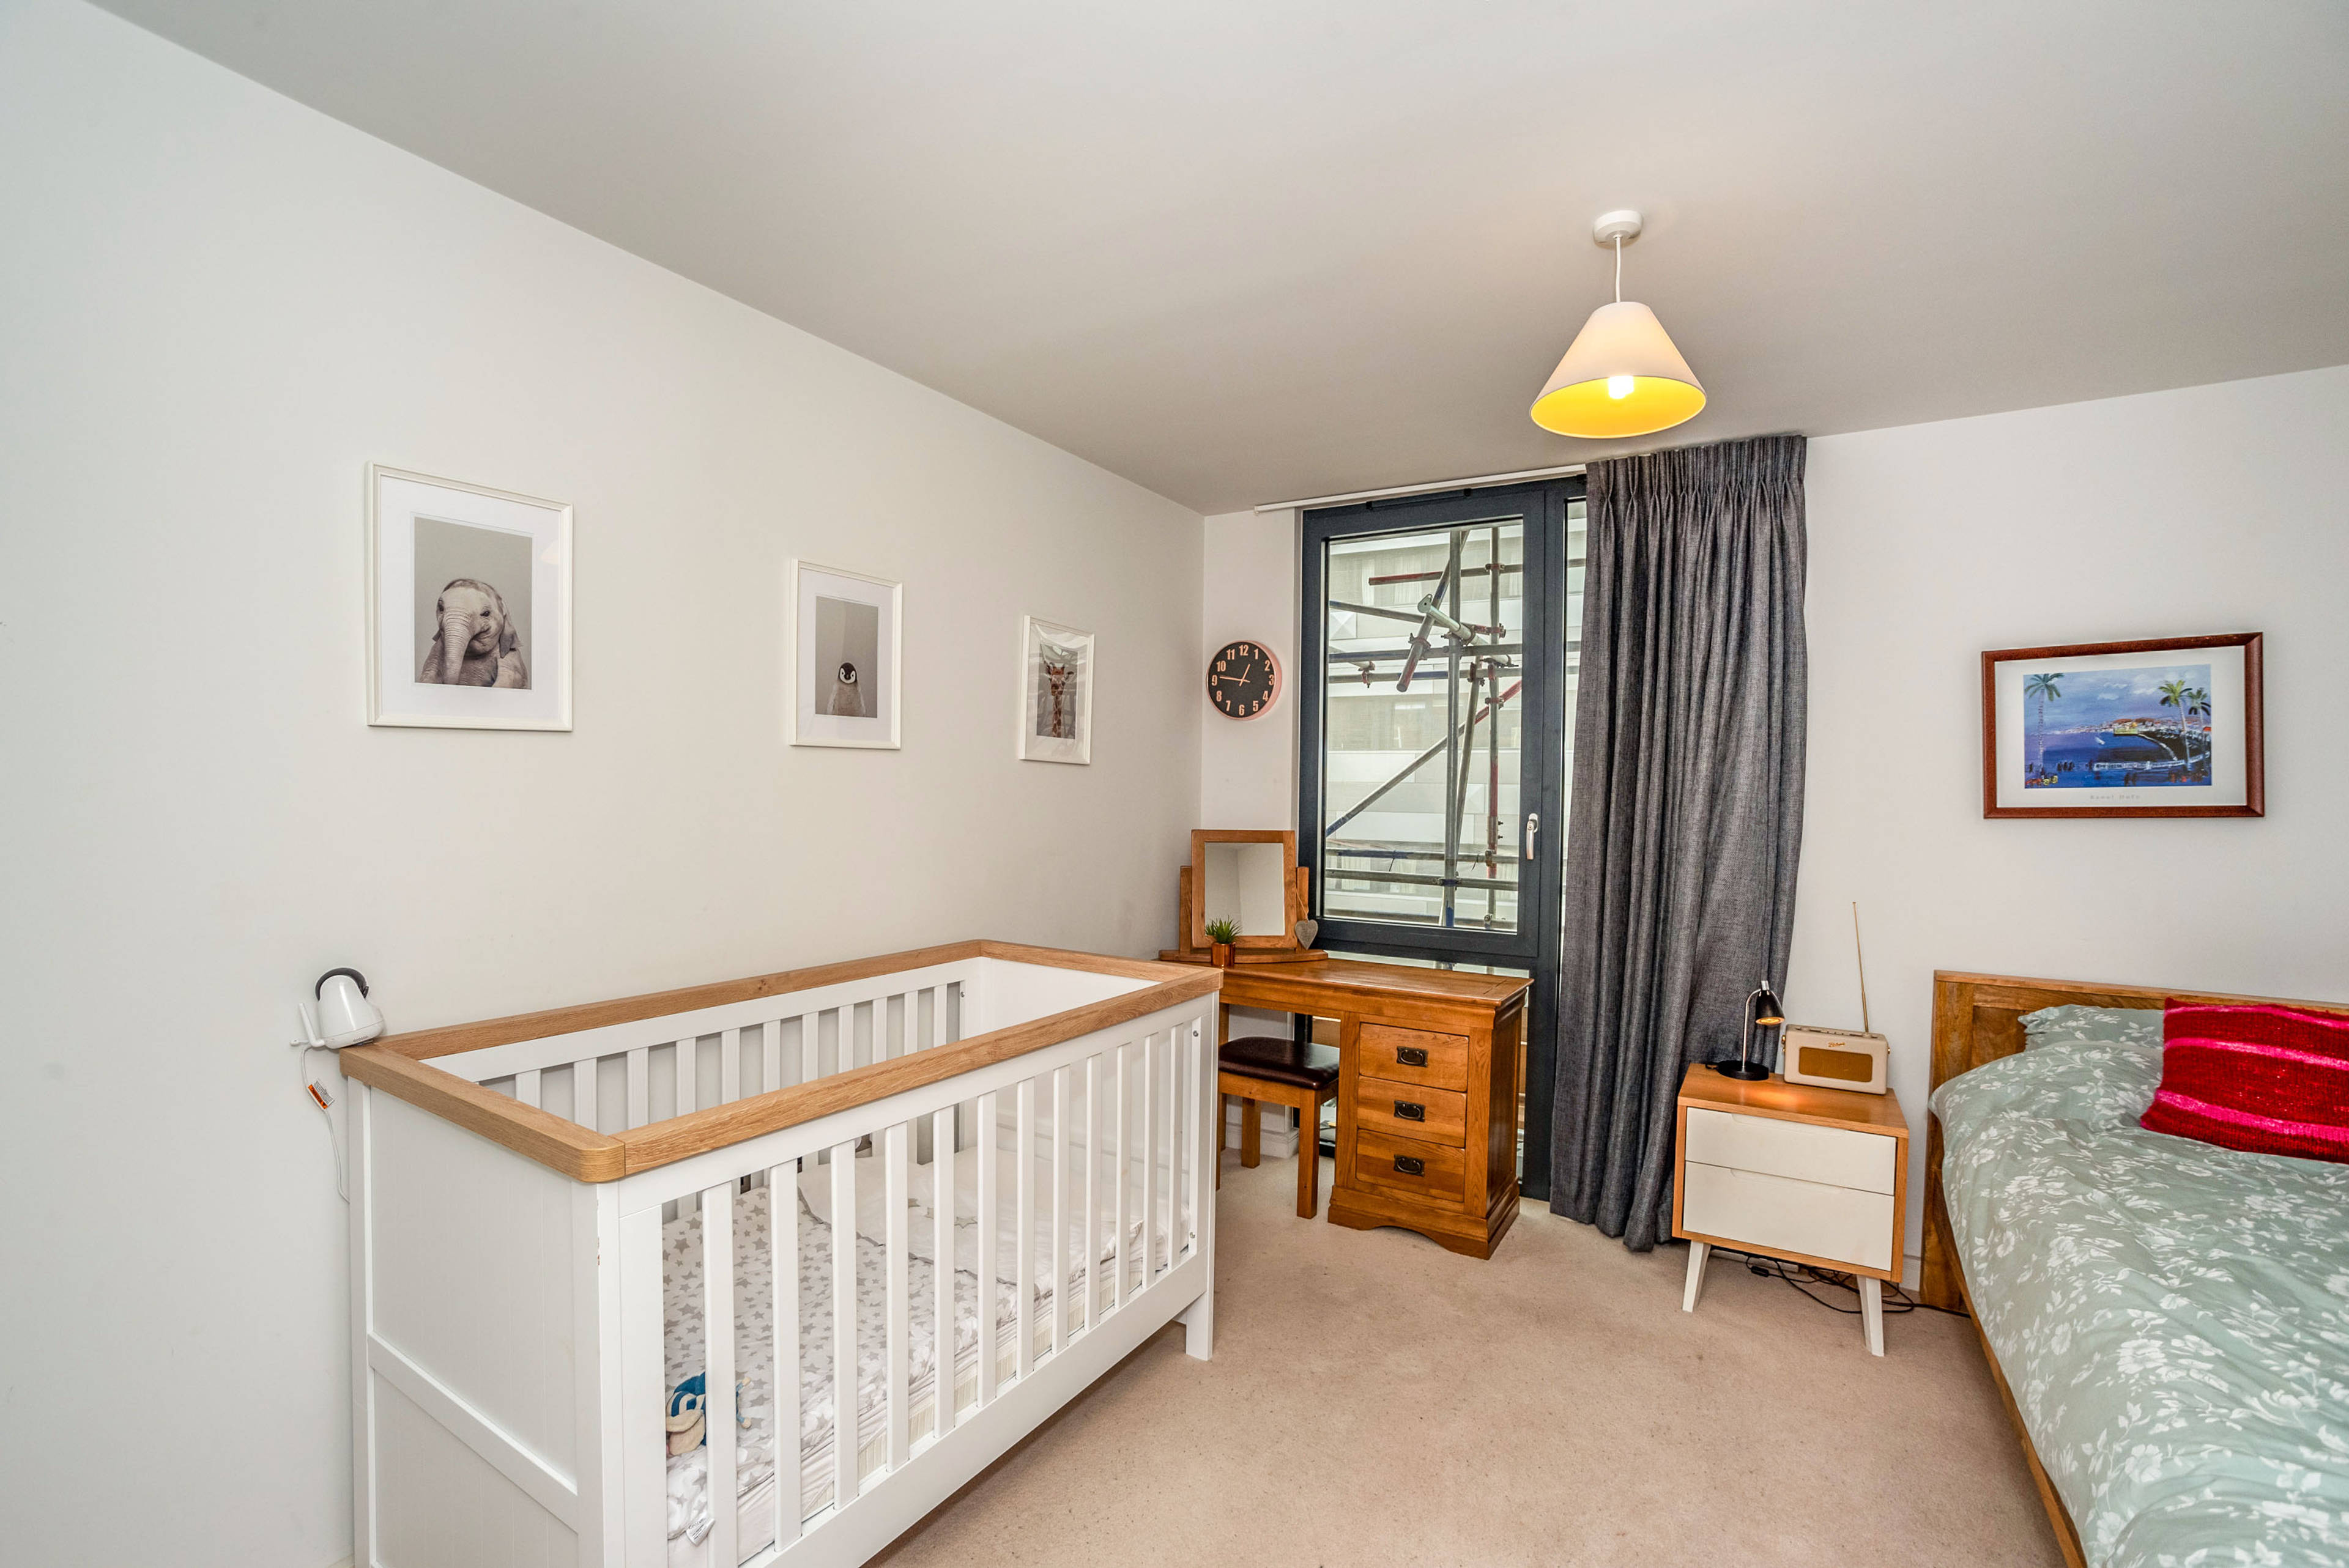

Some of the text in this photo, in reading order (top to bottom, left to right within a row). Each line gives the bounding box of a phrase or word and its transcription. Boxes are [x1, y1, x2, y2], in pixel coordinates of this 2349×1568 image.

[1226, 649, 1235, 660] 11
[1239, 645, 1249, 656] 12
[1254, 648, 1258, 660] 1
[1216, 660, 1226, 671] 10
[1264, 660, 1271, 671] 2
[1211, 675, 1217, 686] 9
[1268, 675, 1274, 686] 3
[1216, 690, 1222, 701] 8
[1263, 690, 1269, 701] 4
[1226, 700, 1231, 711] 7
[1239, 704, 1245, 716] 6
[1252, 700, 1259, 711] 5
